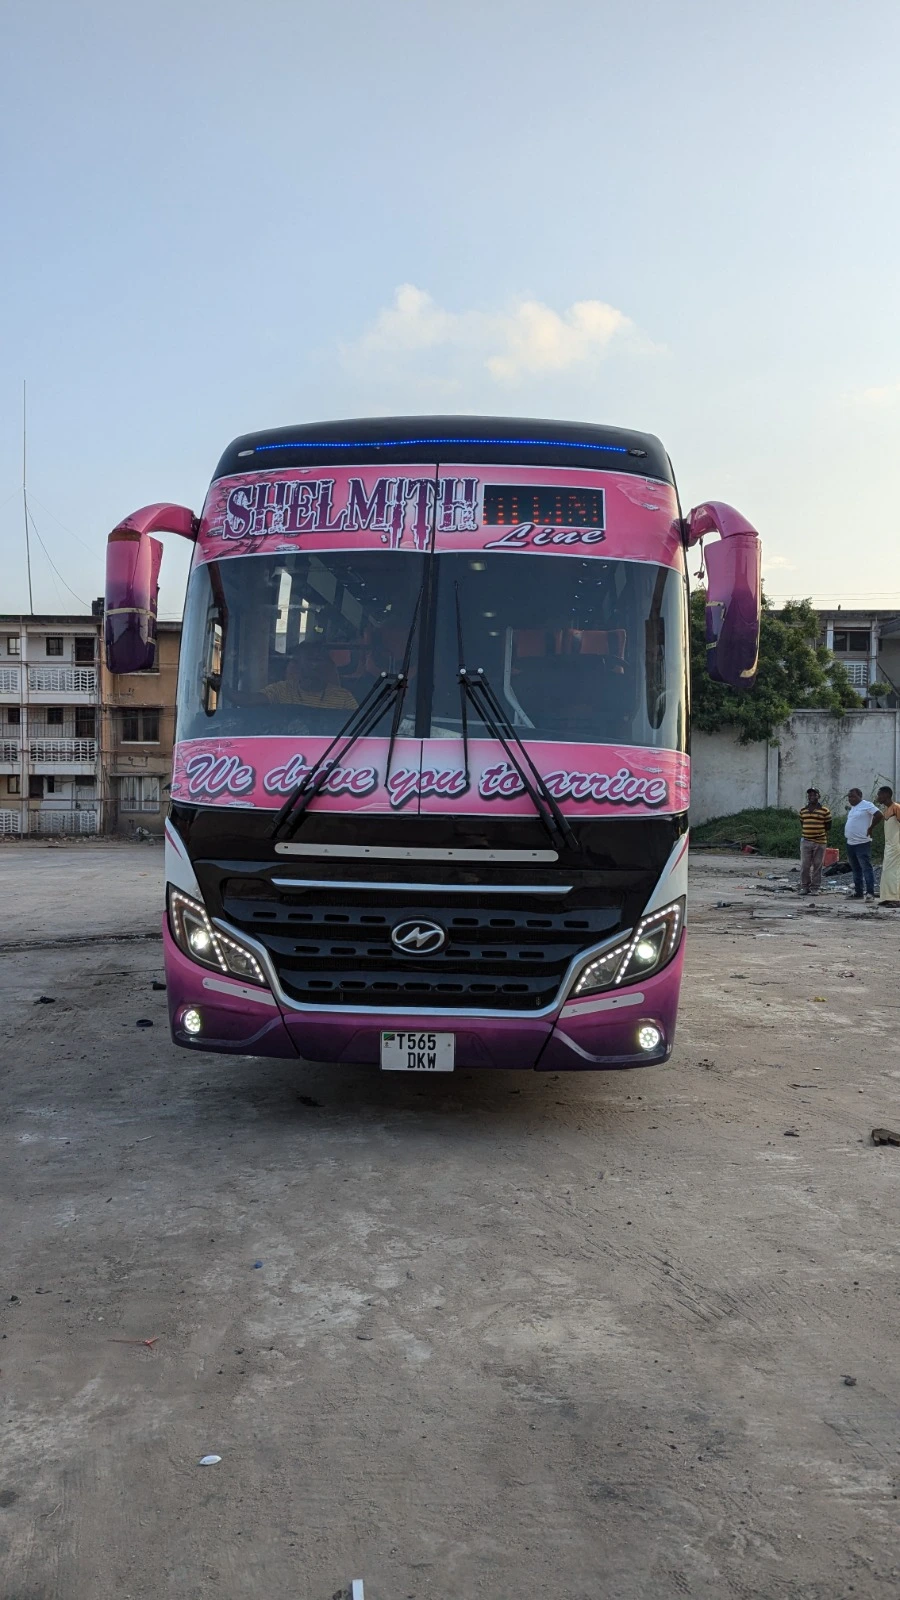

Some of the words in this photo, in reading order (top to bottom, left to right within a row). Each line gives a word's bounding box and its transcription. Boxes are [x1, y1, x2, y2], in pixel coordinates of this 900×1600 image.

[223, 477, 479, 550] SHELMITH
[484, 522, 605, 549] Line
[187, 753, 253, 794] We
[263, 753, 375, 793] drive
[388, 768, 467, 807] you
[480, 762, 524, 796] to
[538, 768, 667, 804] arrive
[396, 1033, 437, 1051] T565
[407, 1051, 437, 1069] DKW
